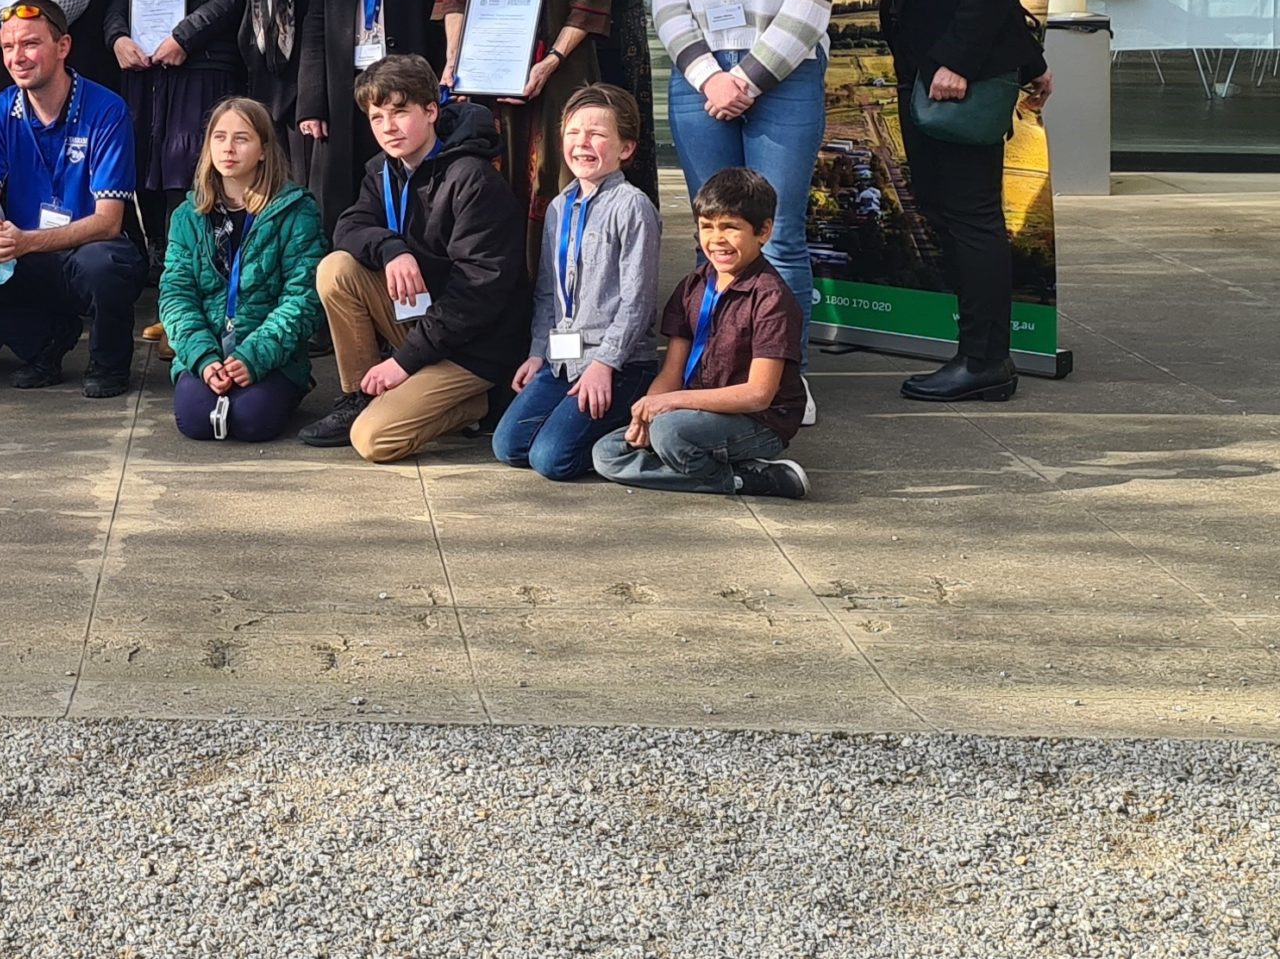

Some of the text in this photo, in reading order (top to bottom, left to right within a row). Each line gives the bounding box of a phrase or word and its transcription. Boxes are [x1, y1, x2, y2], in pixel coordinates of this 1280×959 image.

[825, 295, 892, 312] 1800 170 020
